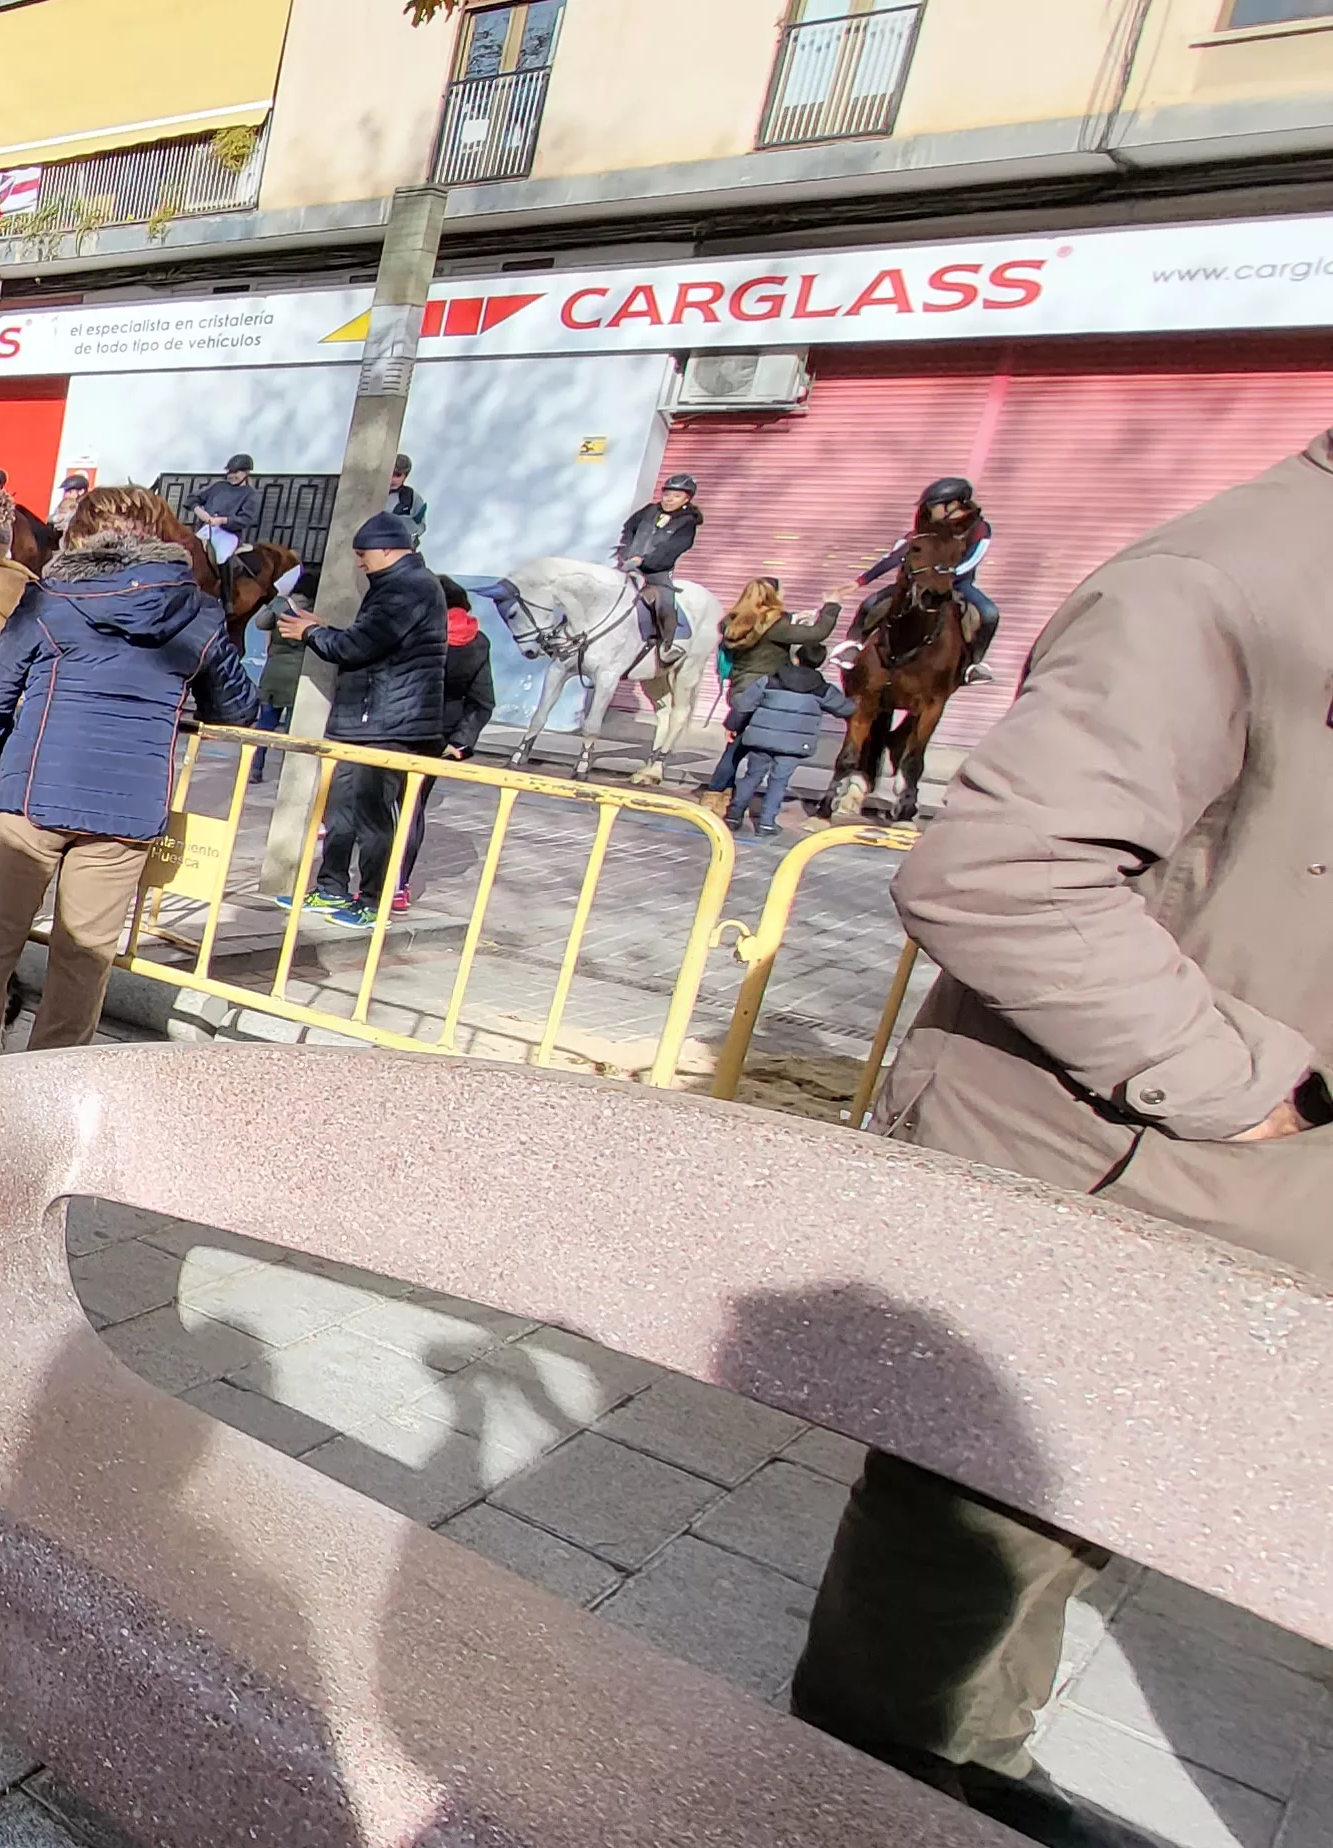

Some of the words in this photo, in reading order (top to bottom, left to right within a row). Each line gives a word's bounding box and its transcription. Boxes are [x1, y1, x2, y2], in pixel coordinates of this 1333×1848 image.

[560, 259, 1047, 330] CARGLASS
[69, 323, 83, 337] el
[86, 319, 170, 338] especialista
[175, 318, 194, 331] en
[198, 309, 275, 330] cristalería
[74, 342, 92, 355] de
[96, 340, 129, 354] todo
[132, 339, 159, 356] tipo
[164, 337, 184, 351] de
[188, 332, 262, 350] vehículos
[150, 846, 200, 869] Huesca
